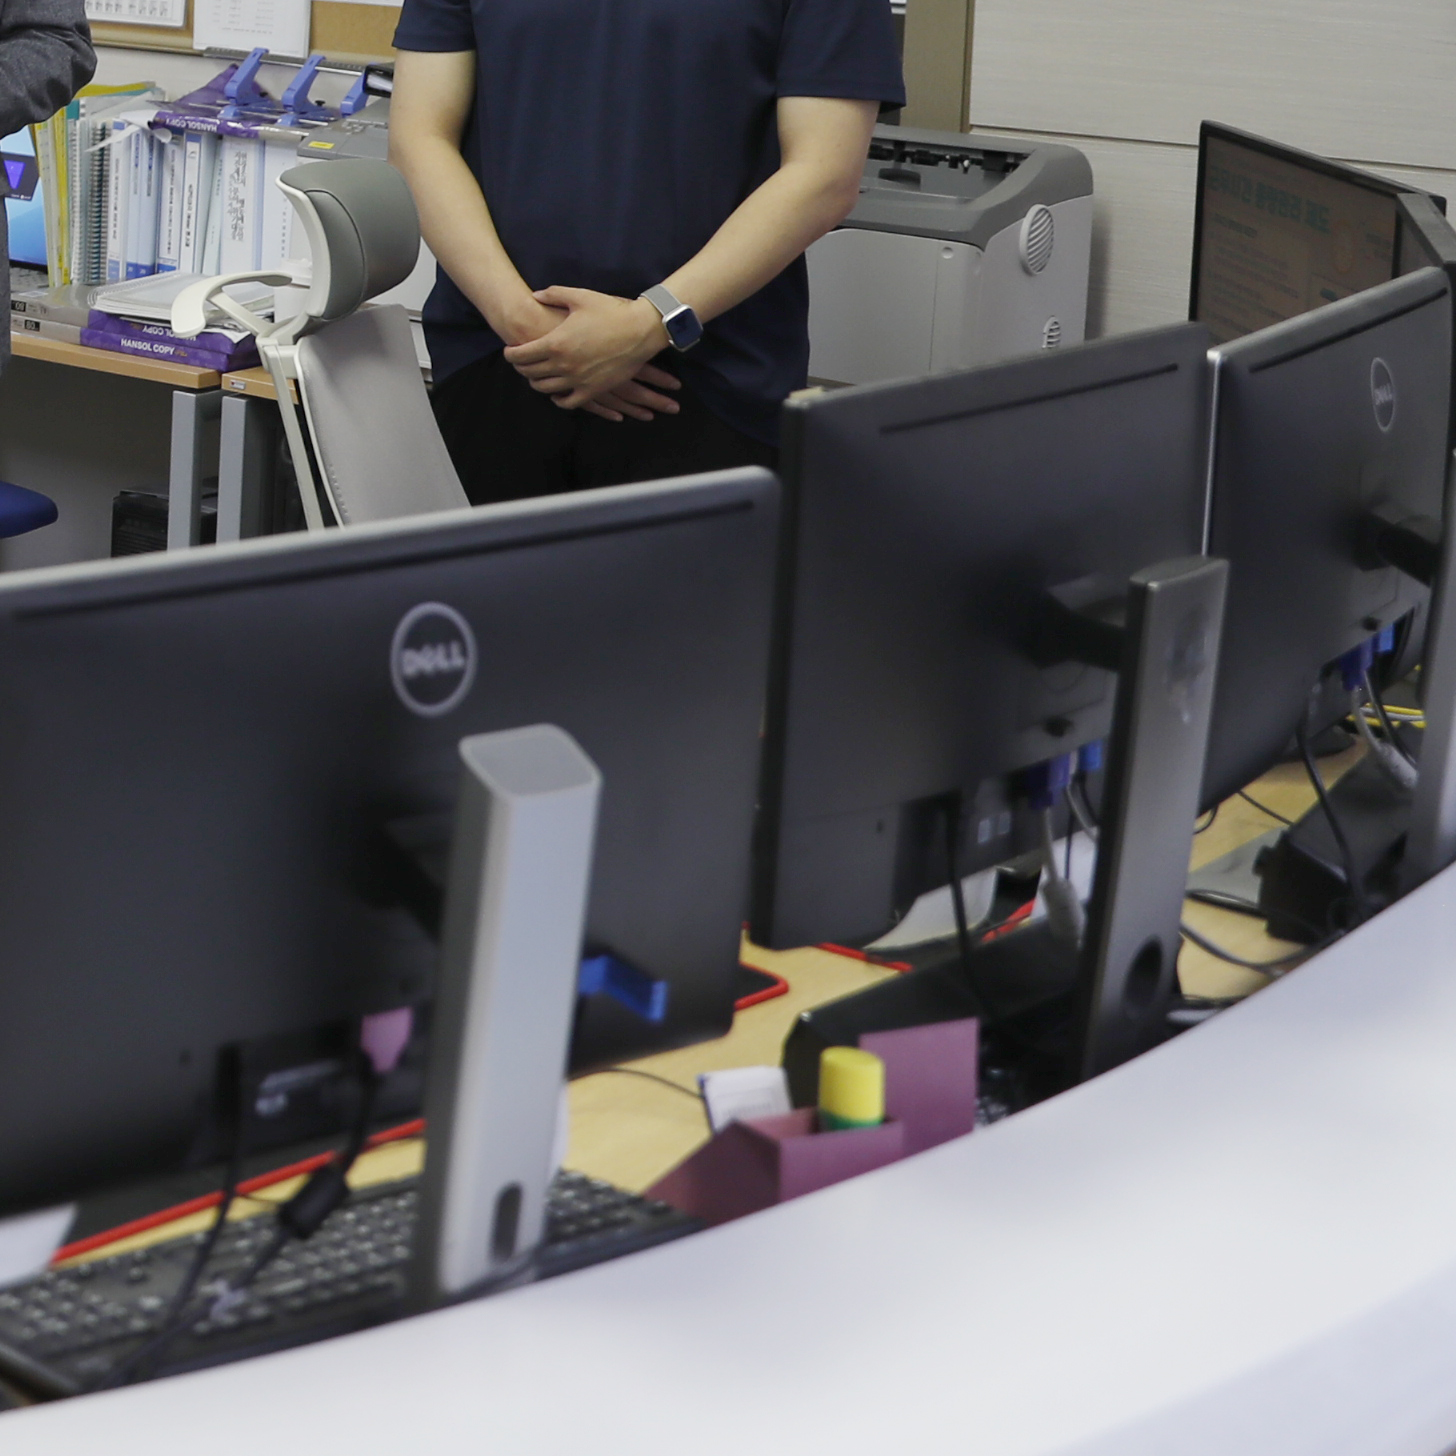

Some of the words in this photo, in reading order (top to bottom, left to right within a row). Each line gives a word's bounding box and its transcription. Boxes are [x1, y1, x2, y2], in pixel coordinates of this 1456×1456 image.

[120, 338, 152, 352] HANSOL
[152, 343, 175, 356] COPY
[401, 641, 465, 675] DELL
